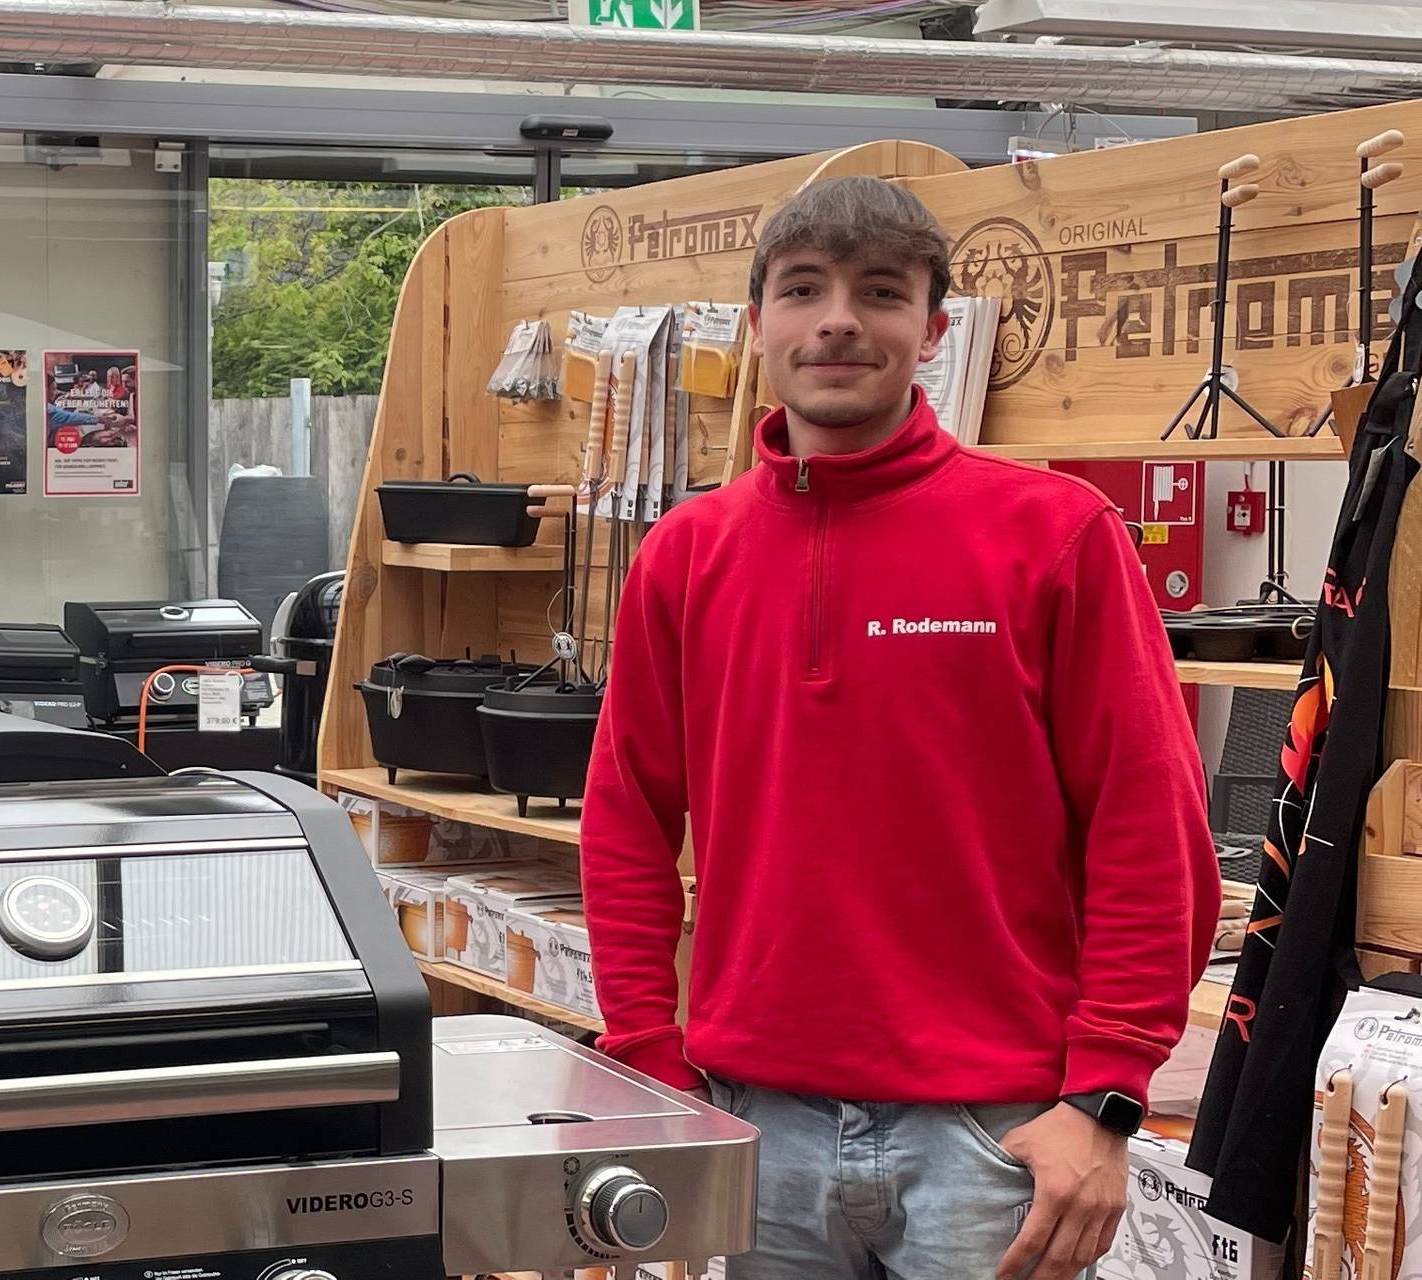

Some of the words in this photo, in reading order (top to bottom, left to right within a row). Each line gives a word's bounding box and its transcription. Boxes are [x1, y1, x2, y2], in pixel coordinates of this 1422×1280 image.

[628, 203, 764, 262] Petromax
[1058, 217, 1149, 246] ORIGINAL
[1060, 242, 1409, 363] Petroma
[101, 388, 115, 397] DIE
[868, 620, 887, 637] R.
[892, 618, 997, 635] Rodemann
[1377, 1024, 1422, 1047] Petrom
[1164, 1180, 1210, 1212] Petro
